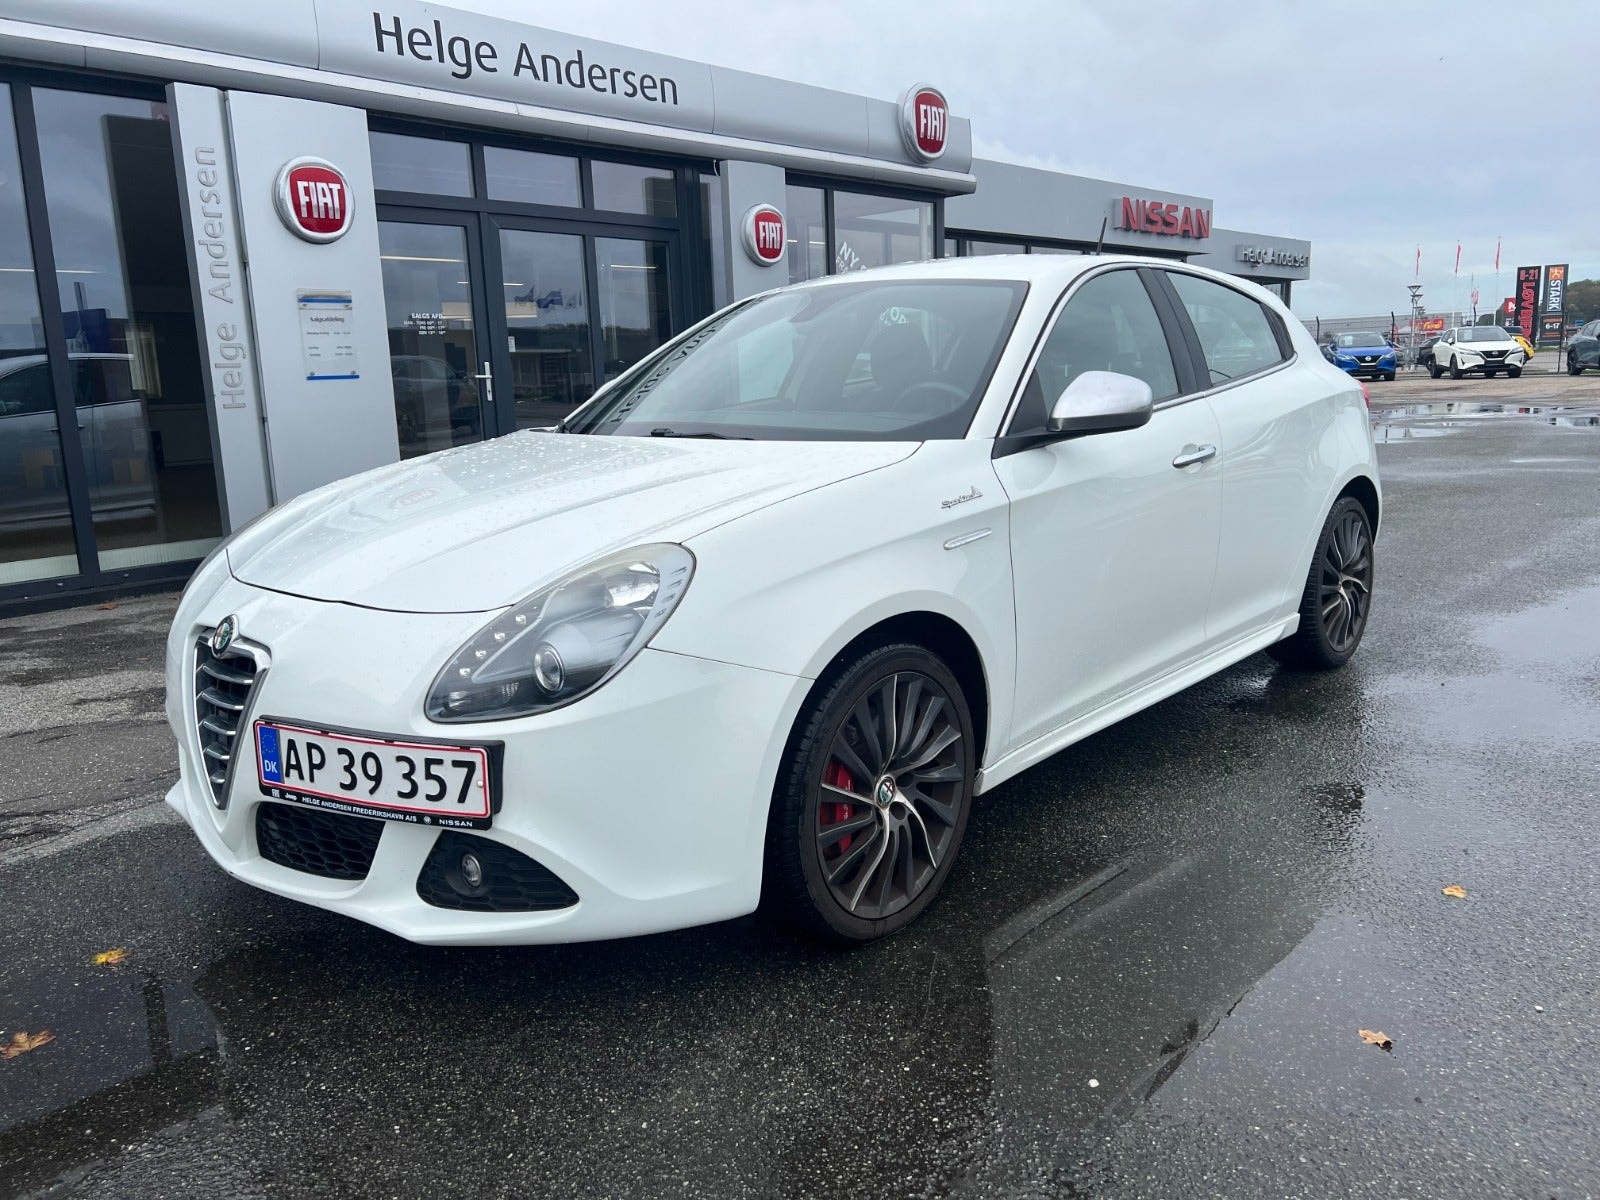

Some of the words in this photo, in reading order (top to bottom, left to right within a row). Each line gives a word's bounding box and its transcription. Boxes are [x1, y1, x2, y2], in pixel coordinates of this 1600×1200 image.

[373, 12, 498, 79] Helge
[513, 42, 678, 105] Andersen
[920, 104, 945, 141] FIAT
[297, 180, 342, 220] FIAT
[1122, 196, 1210, 238] NISSAN
[195, 146, 234, 304] Andersen
[758, 221, 782, 250] FIAT
[840, 241, 860, 268] NY
[1548, 280, 1561, 310] STARK
[215, 322, 246, 409] Helge
[264, 759, 278, 774] DK
[285, 738, 326, 783] AP
[337, 747, 383, 795] 39
[395, 755, 476, 804] 357
[302, 796, 320, 806] HELGE
[321, 800, 352, 812] ANDERSEN
[352, 806, 404, 820] FREDERIKSHAVN
[405, 815, 417, 823] A/S
[439, 819, 473, 828] NISSAN
